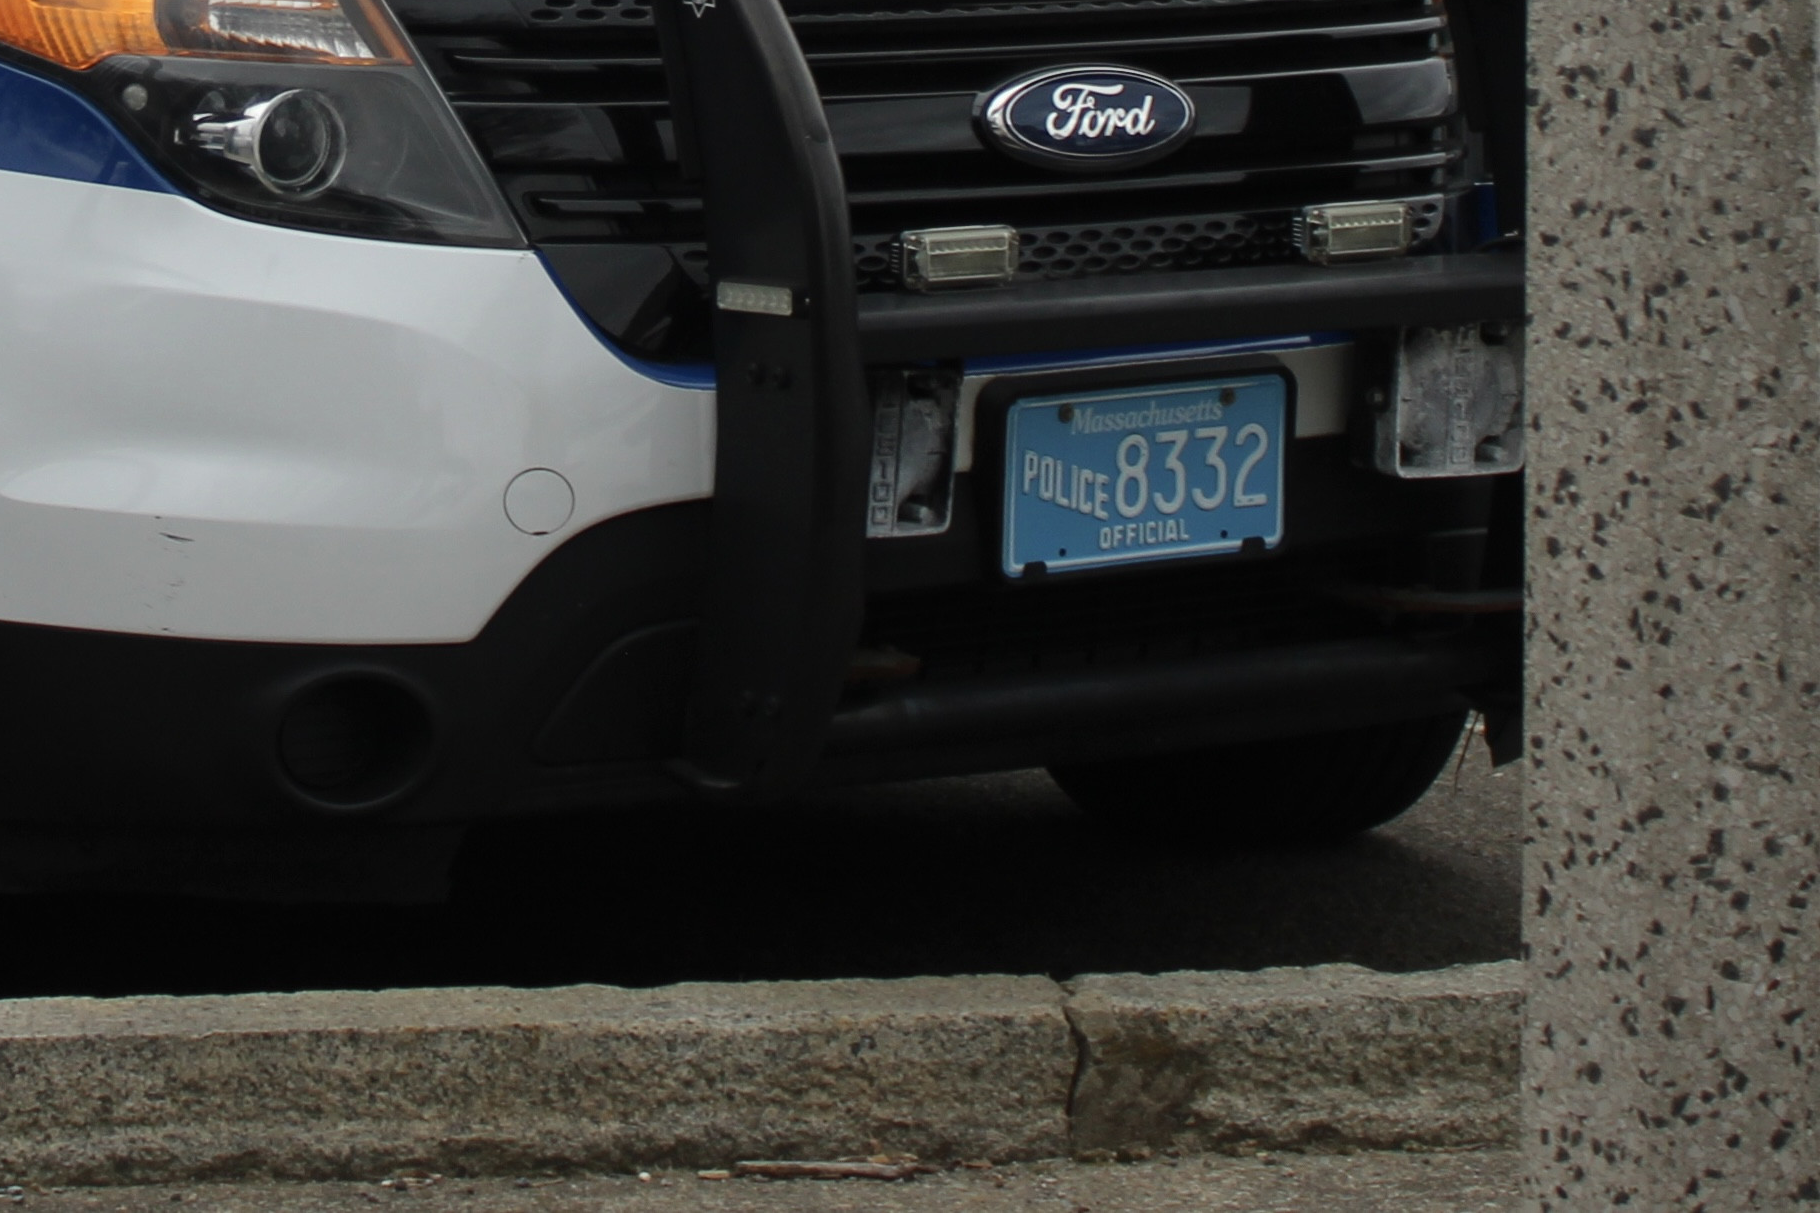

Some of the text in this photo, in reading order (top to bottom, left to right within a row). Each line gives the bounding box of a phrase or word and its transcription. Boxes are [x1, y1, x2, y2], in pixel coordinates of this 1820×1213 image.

[1045, 83, 1156, 140] Ford
[1071, 399, 1224, 435] Massachusetts
[1023, 423, 1269, 521] POLICE 8332
[1099, 518, 1190, 550] OFFICIAL
